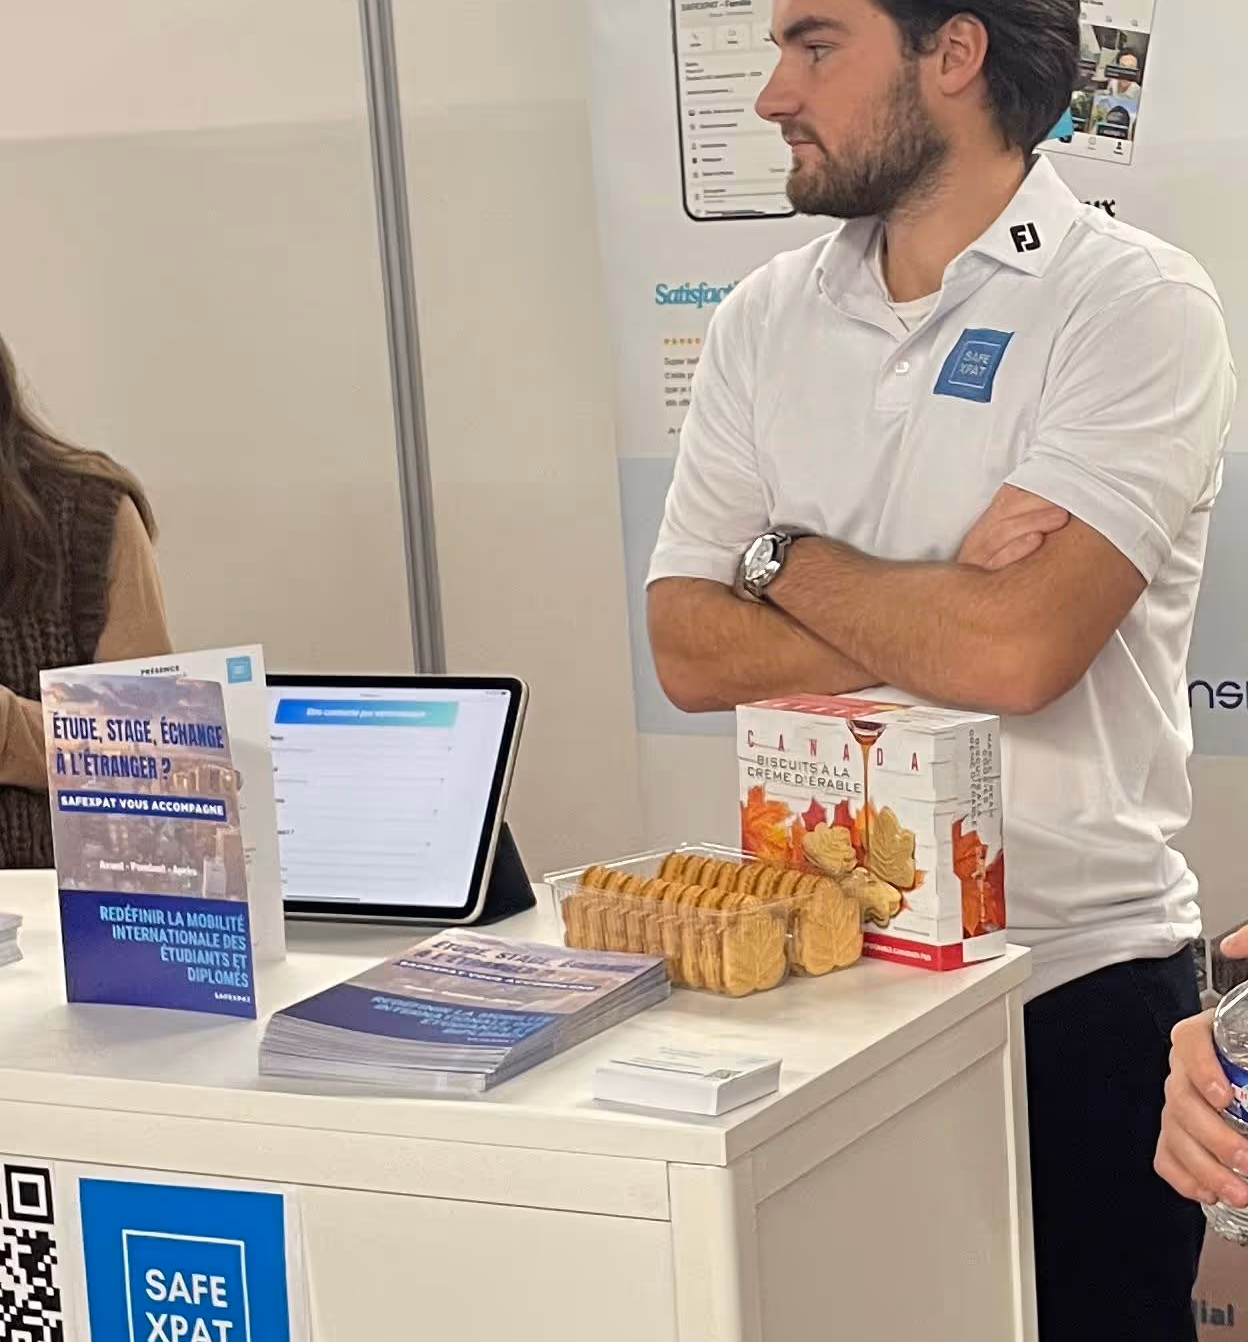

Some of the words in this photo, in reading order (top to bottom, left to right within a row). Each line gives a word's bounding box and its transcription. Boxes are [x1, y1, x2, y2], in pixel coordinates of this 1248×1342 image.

[965, 350, 991, 364] SAFE
[53, 712, 103, 744] ÉTUDE,
[107, 719, 157, 745] STAGE,
[160, 716, 224, 748] ÉCHANGE
[71, 748, 157, 779] L'ÉTRANGER
[162, 758, 171, 780] ?
[748, 730, 919, 771] CANADA
[757, 755, 817, 772] BISCUITS
[834, 766, 850, 778] LA
[61, 795, 116, 808] SAFEXPAT
[119, 798, 148, 811] VOUS
[151, 800, 224, 816] ACCOMPAGNE
[100, 904, 165, 925] REDÉFINIR
[167, 911, 184, 926] LA
[187, 912, 245, 933] MOBILITÉ
[112, 925, 220, 948] INTERNATIONALE
[222, 933, 246, 951] DES
[160, 944, 229, 967] ÉTUDIANTS
[232, 953, 247, 970] ET
[145, 1268, 229, 1308] SAFE
